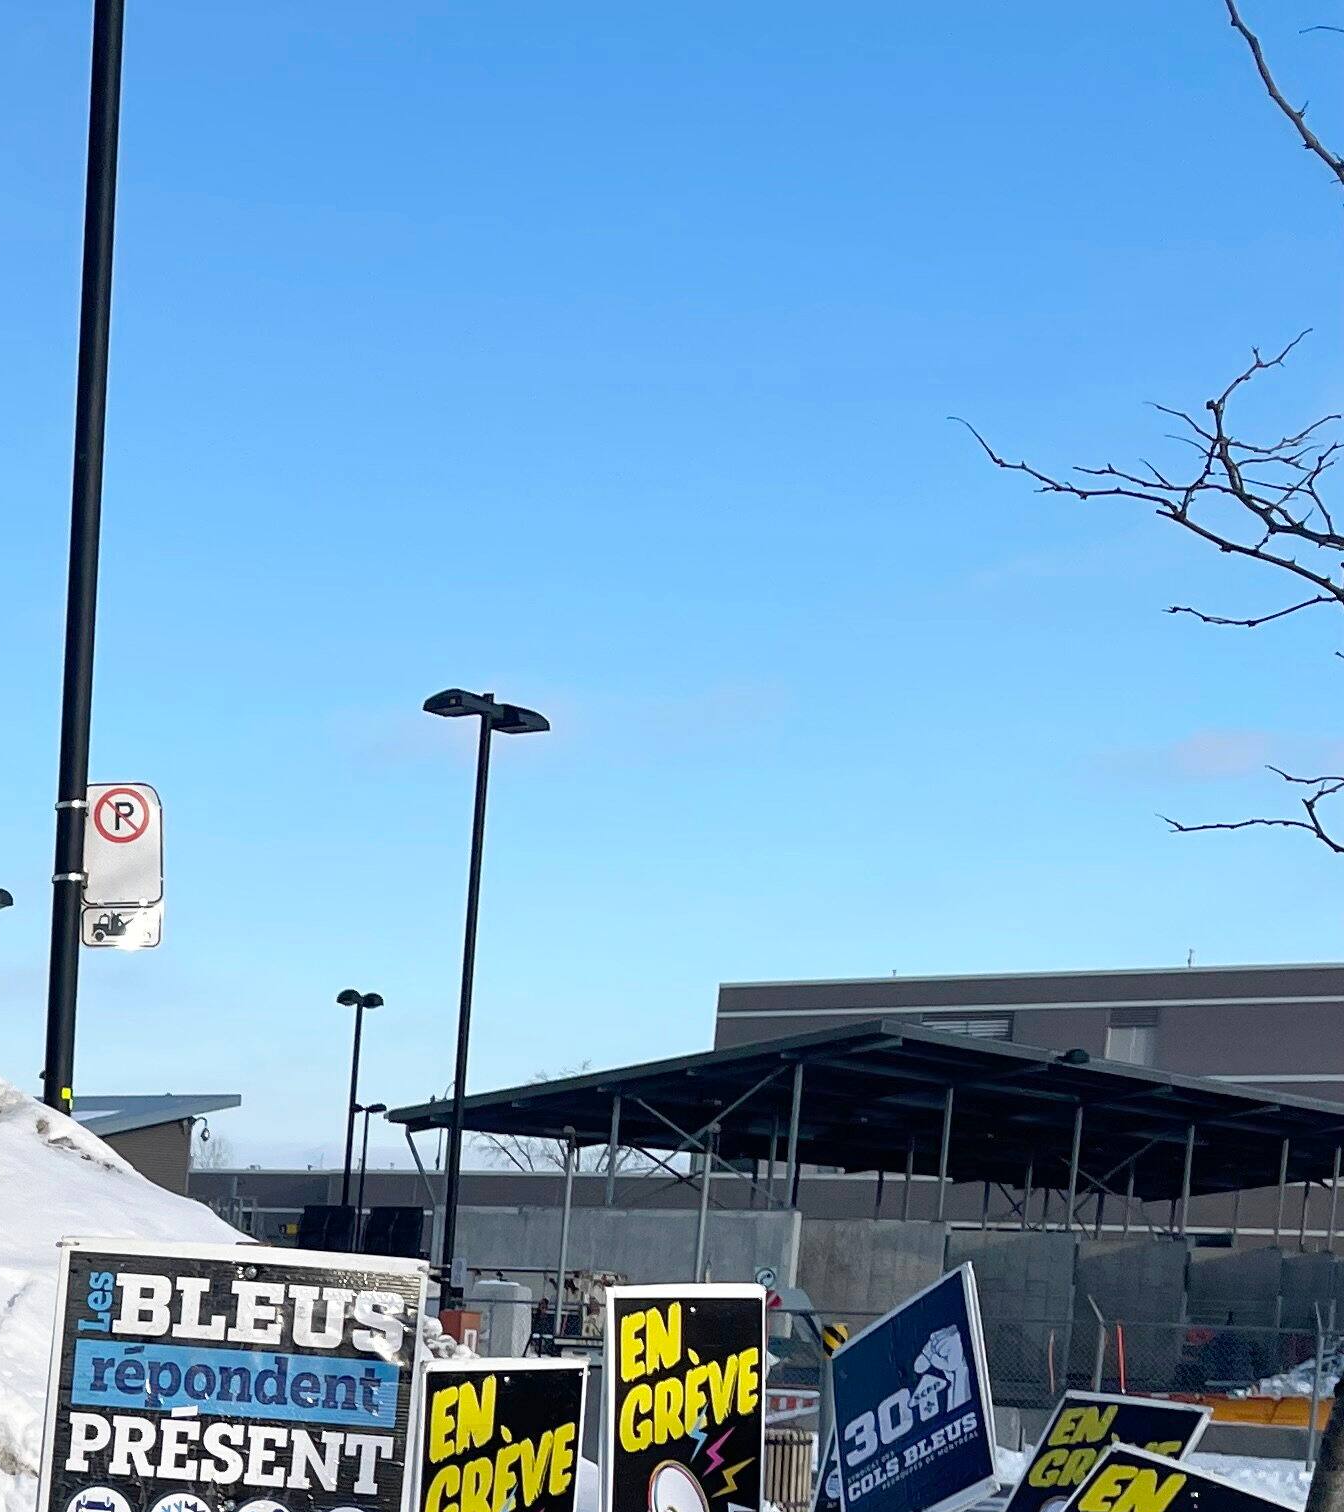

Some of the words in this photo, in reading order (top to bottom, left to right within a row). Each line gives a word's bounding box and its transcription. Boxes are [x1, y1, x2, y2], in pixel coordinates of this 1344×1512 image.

[77, 1271, 114, 1333] Les
[112, 1272, 405, 1352] BLEUS
[621, 1301, 681, 1382] EN
[89, 1346, 382, 1414] répondent
[429, 1374, 496, 1464] EN
[619, 1348, 759, 1453] GRÈVE
[65, 1405, 394, 1495] PRÉSENT
[848, 1457, 899, 1502] COLS
[903, 1411, 978, 1468] BLEUS
[1048, 1405, 1118, 1446] EN
